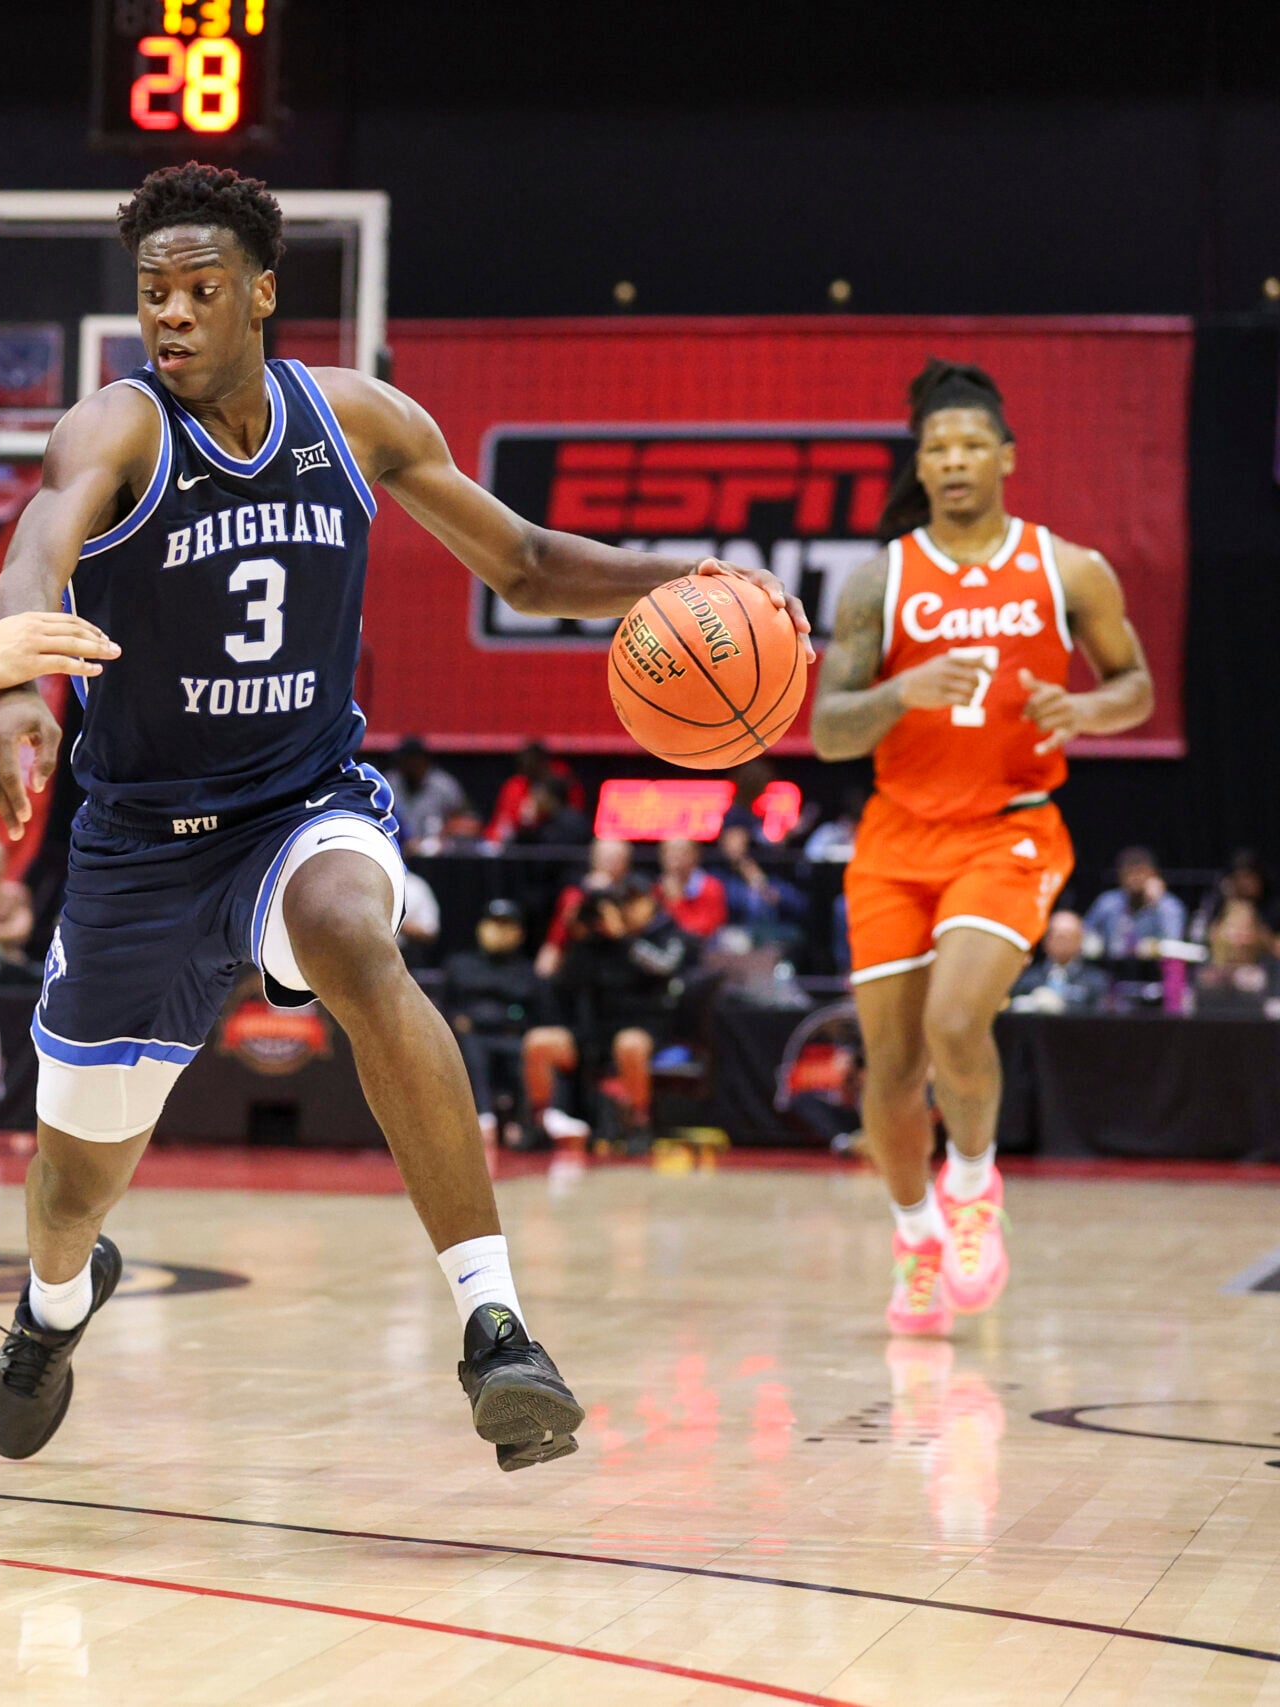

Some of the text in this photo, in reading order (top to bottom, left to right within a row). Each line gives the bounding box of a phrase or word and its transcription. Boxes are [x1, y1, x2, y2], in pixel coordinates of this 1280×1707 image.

[130, 36, 241, 132] 28
[546, 441, 893, 534] ESPN
[162, 503, 346, 569] BRIGHAM
[224, 557, 286, 663] 3
[901, 592, 1045, 643] Canes
[180, 670, 316, 715] YOUNG
[947, 645, 999, 727] 7
[172, 815, 218, 835] BYU
